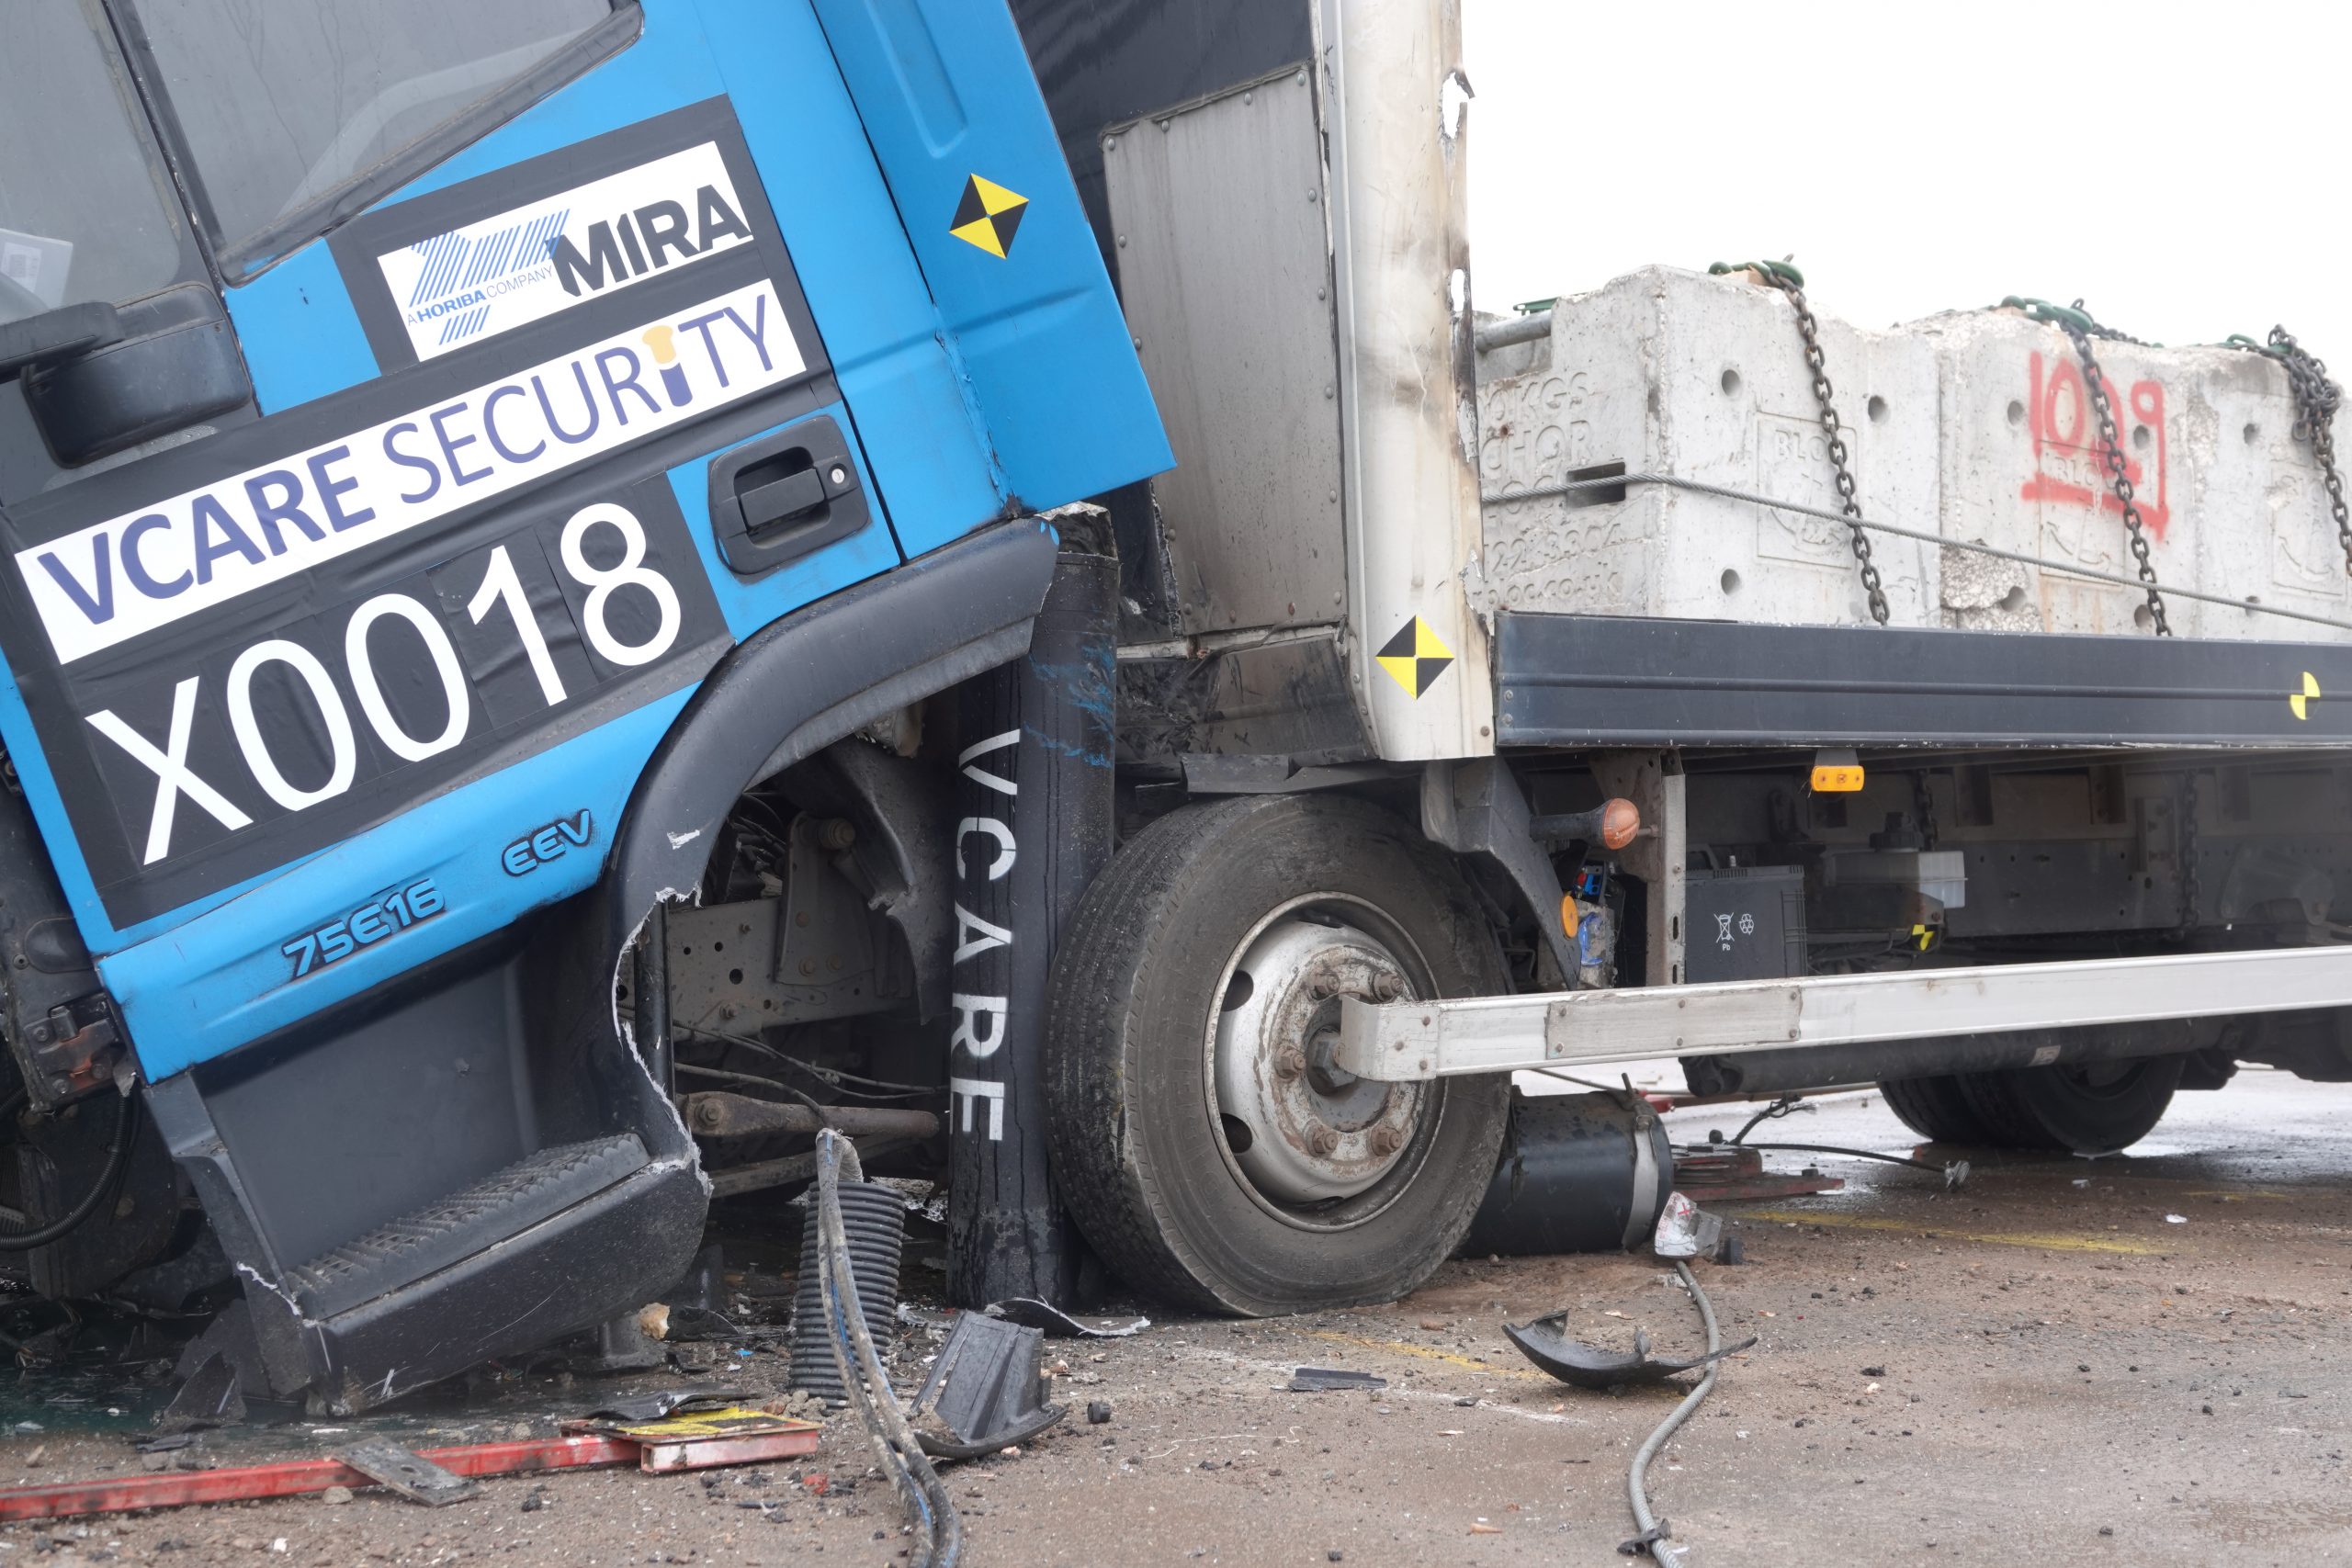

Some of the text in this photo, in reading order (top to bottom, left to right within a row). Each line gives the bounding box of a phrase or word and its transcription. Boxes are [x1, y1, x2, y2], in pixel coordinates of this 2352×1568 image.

[546, 184, 753, 297] MIRA
[407, 265, 554, 327] A HORIBA COMPANY
[39, 294, 776, 626] VCARE SECURITY
[1481, 419, 1594, 472] CHOR
[1774, 428, 1828, 462] BLO
[85, 502, 682, 866] X0018
[503, 808, 593, 876] EEV
[282, 877, 447, 980] 75E16
[950, 729, 1020, 1140] VCARE
[1722, 942, 1731, 952] Pb
